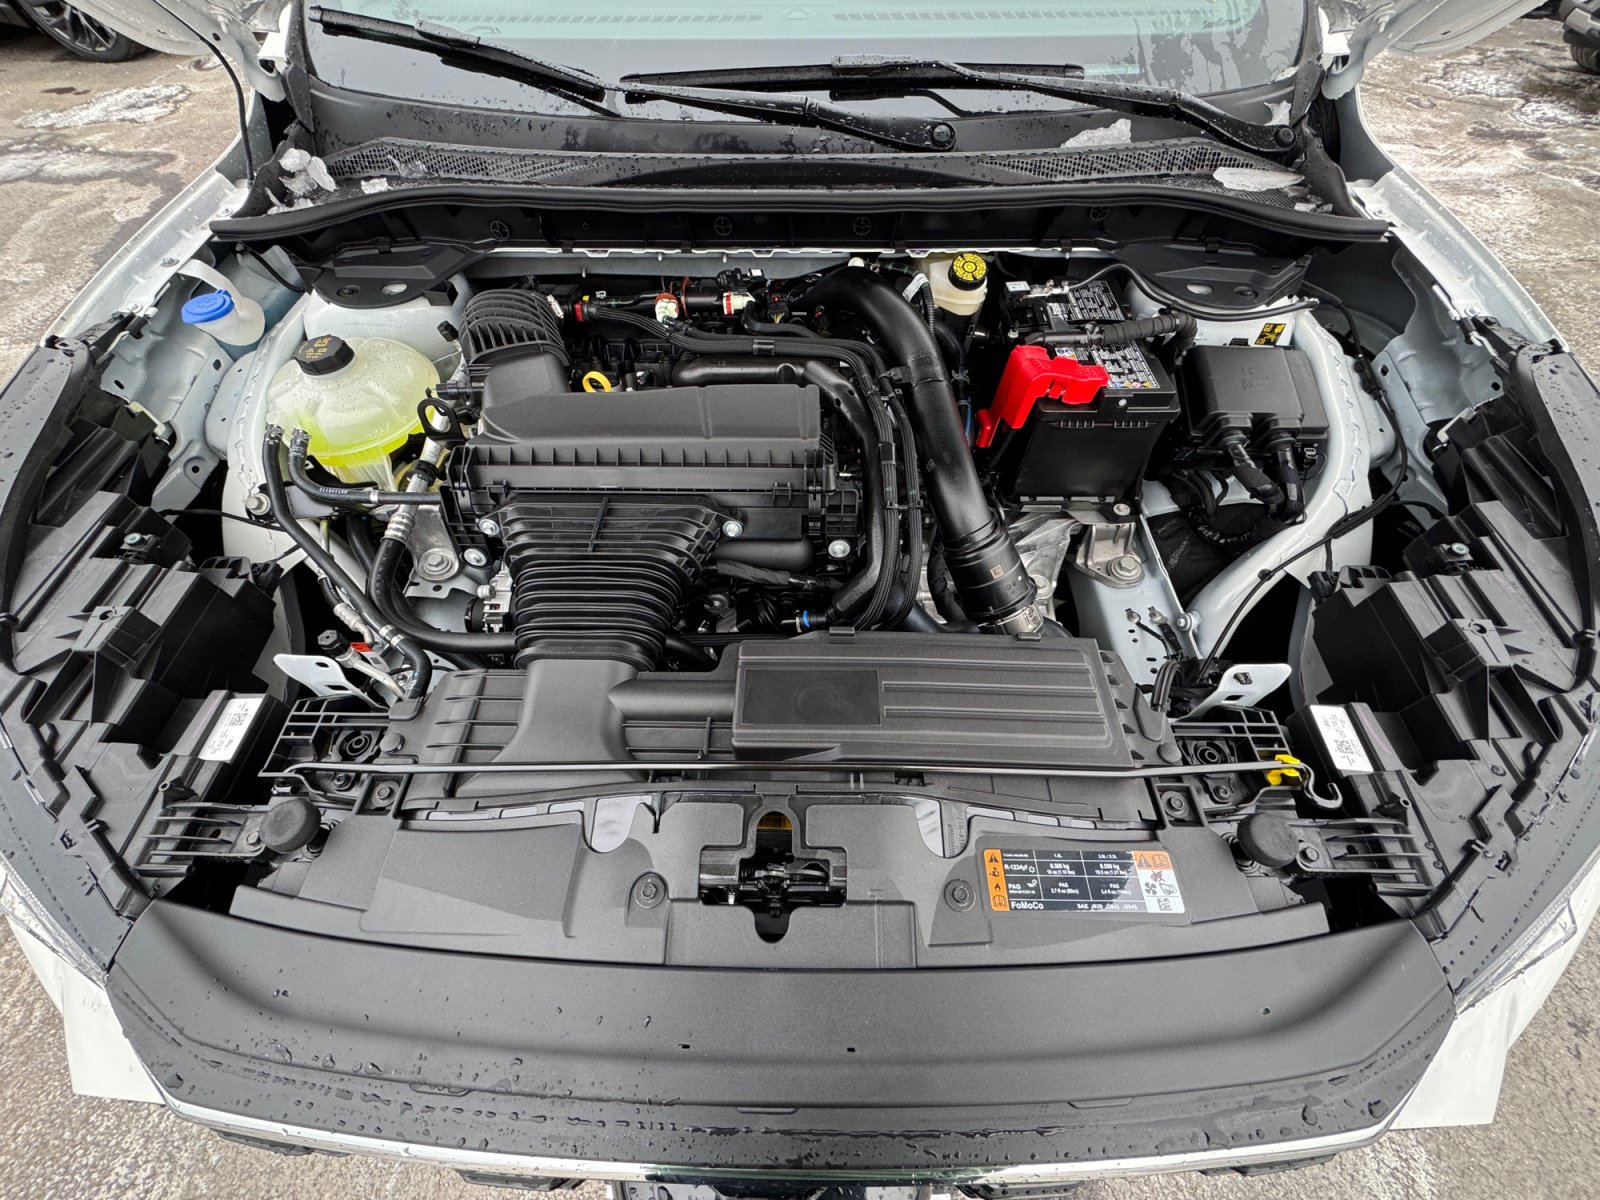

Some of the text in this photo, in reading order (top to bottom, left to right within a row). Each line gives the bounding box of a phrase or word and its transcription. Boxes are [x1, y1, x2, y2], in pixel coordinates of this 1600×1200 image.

[1004, 864, 1028, 872] R-1234yf
[1063, 863, 1071, 871] kg
[1113, 863, 1121, 871] kg
[1010, 901, 1045, 910] FoMoCo
